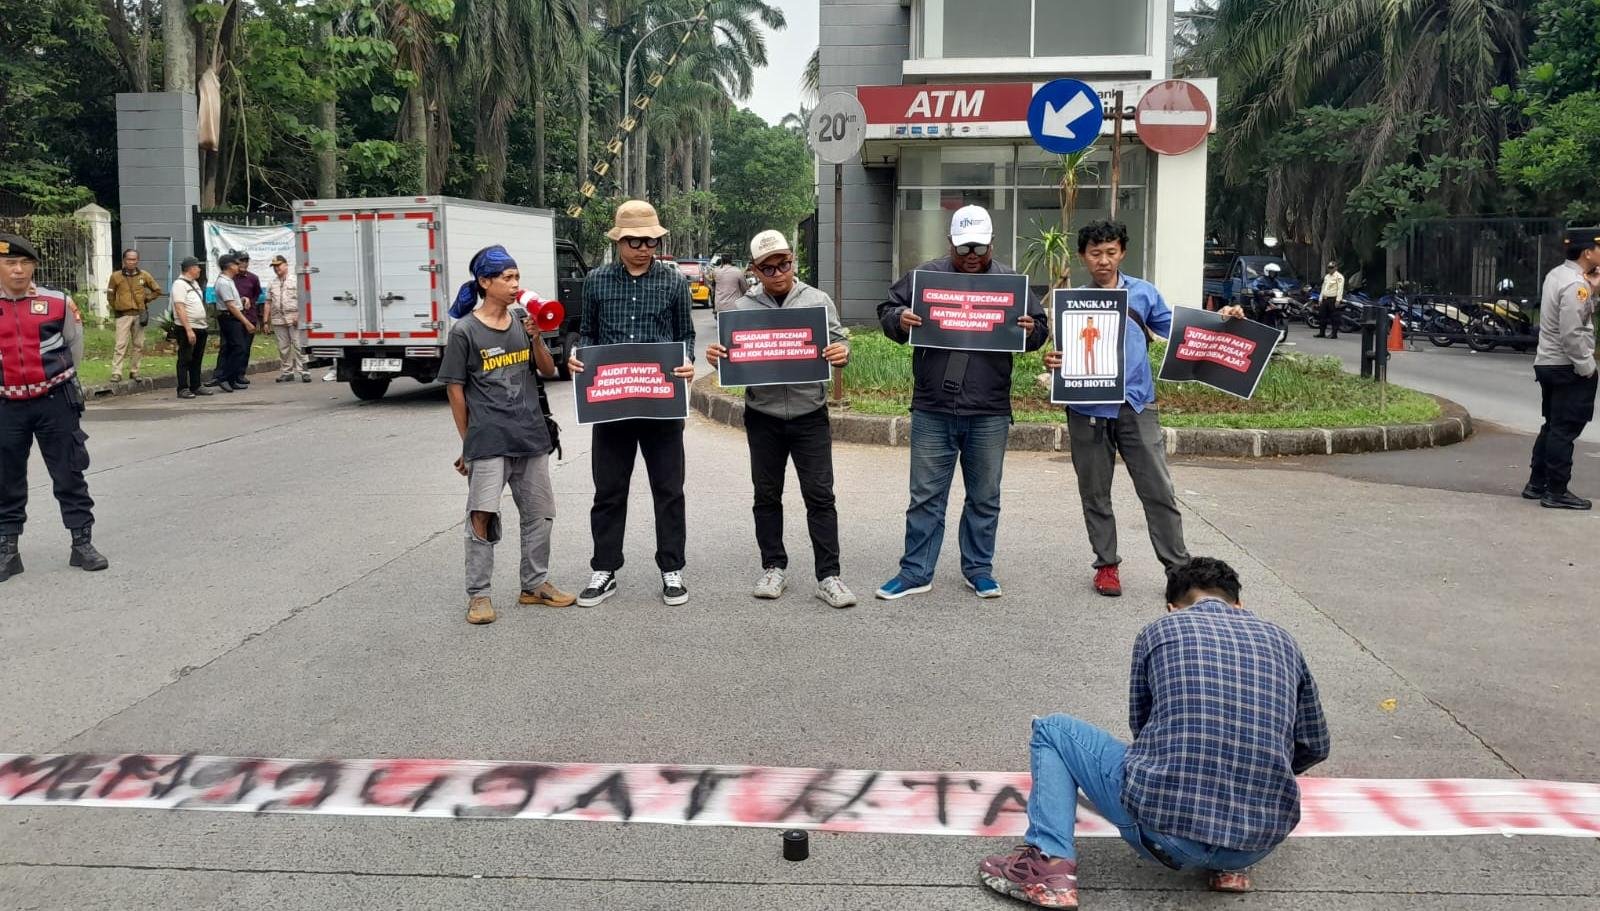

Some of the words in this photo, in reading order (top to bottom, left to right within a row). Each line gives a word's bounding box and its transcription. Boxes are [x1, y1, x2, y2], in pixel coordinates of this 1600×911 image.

[904, 90, 985, 118] ATM
[818, 112, 846, 142] 20
[845, 111, 857, 123] km
[926, 292, 965, 301] CISADANE
[966, 295, 1009, 303] TERCEMAR
[932, 310, 967, 319] MATINYA
[968, 312, 1002, 320] SUMBER
[942, 319, 989, 328] KEHIDUPAN
[735, 333, 770, 341] CISADANE
[772, 331, 808, 339] TERCEMAR
[743, 341, 753, 349] INI
[1230, 339, 1253, 350] MATI
[1218, 344, 1246, 358] RUSAK
[1179, 348, 1195, 356] KLH
[1223, 356, 1246, 367] AJA?
[600, 366, 629, 377] AUDIT
[630, 366, 658, 375] WWTP
[597, 376, 663, 387] PERGUDANGAN
[1064, 379, 1082, 388] BOS
[1083, 379, 1117, 388] BIOTEK
[591, 386, 622, 398] TAMAN
[624, 385, 651, 394] TEKNO
[653, 386, 671, 394] BSD
